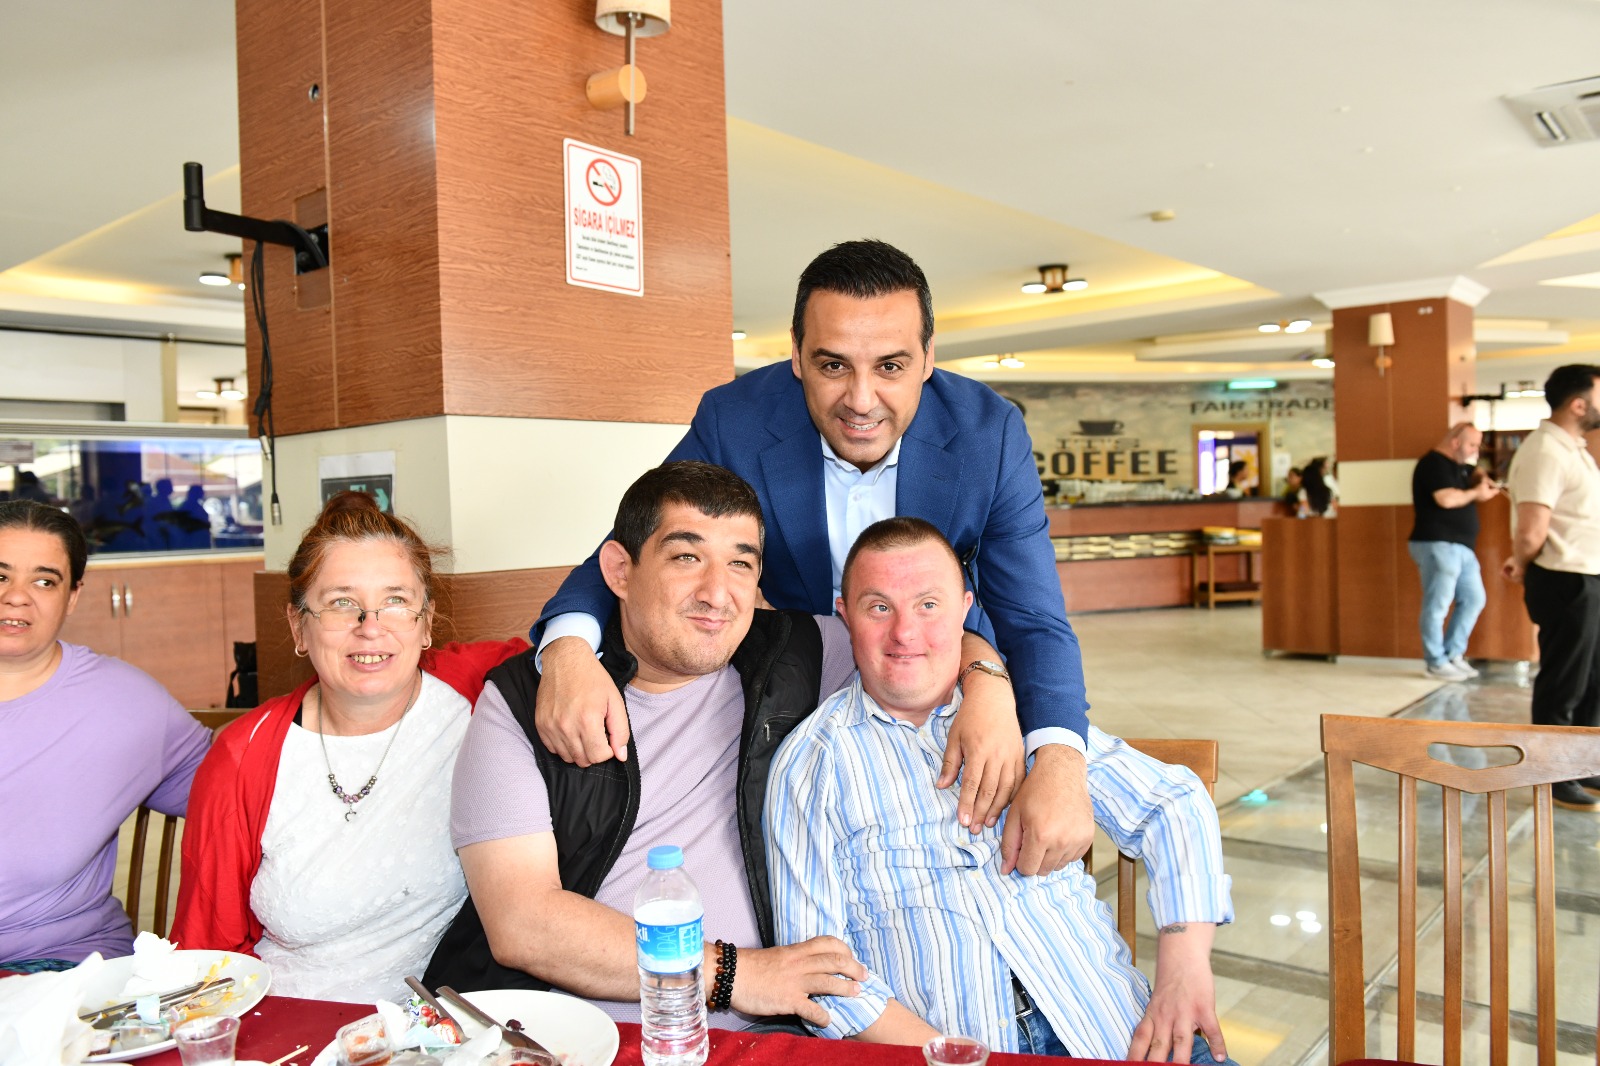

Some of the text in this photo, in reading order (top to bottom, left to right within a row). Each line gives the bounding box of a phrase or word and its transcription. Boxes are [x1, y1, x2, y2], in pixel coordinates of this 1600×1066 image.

[573, 205, 635, 239] SİGARA İÇİLMEZ
[1189, 397, 1335, 416] FAIR TRADE
